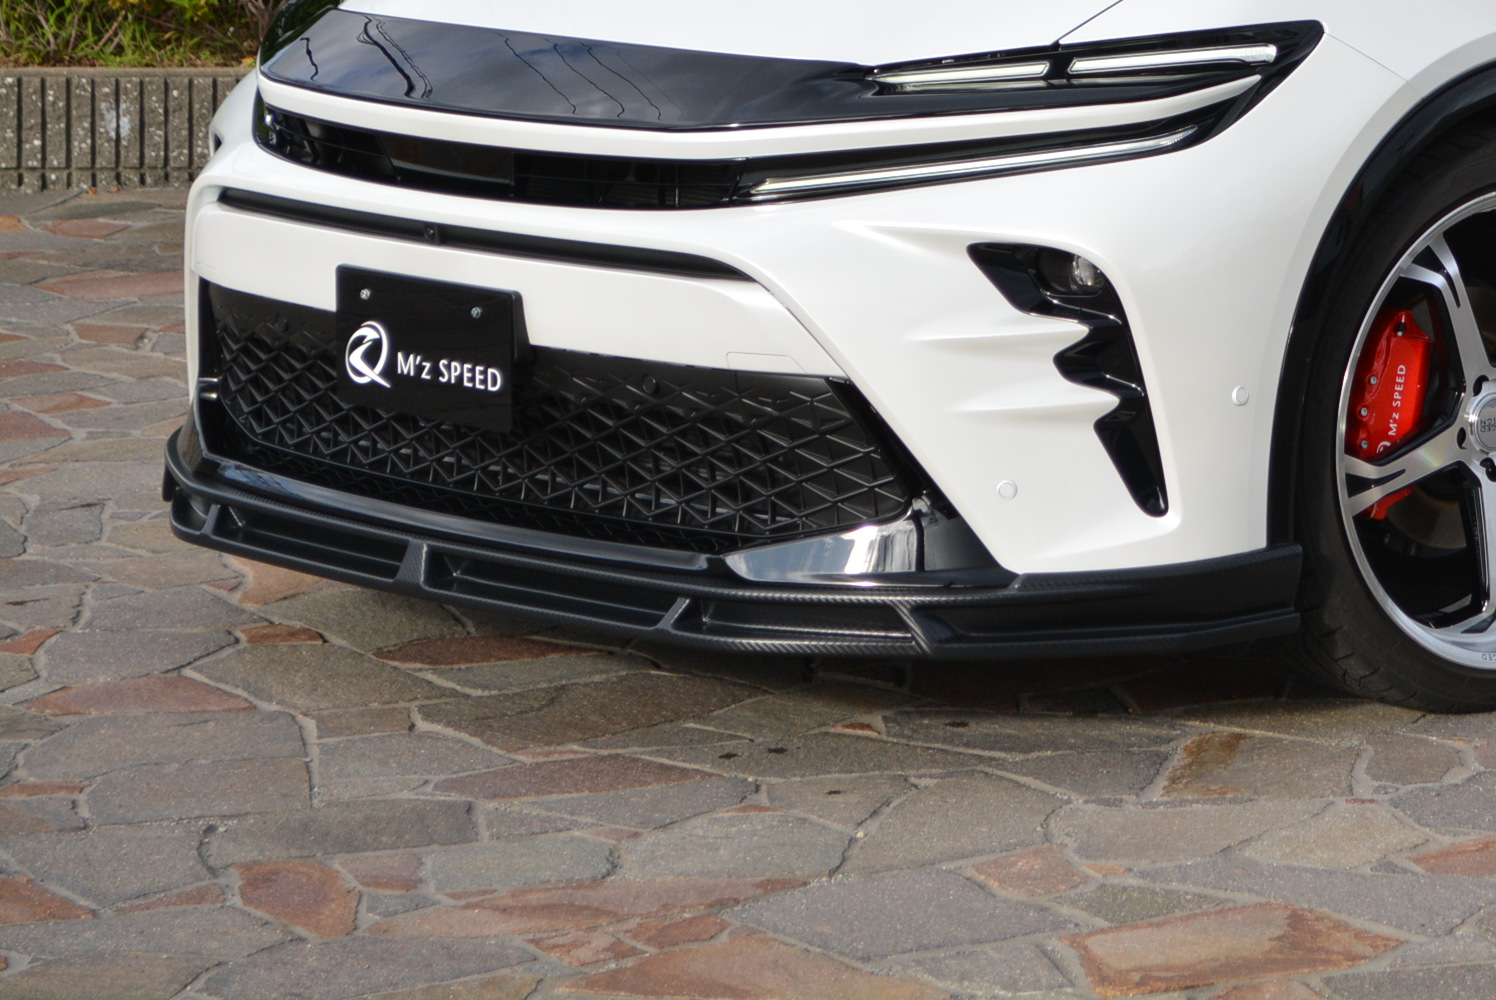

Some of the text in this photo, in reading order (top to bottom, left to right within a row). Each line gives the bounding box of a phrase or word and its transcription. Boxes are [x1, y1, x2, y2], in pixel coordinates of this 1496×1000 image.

[397, 352, 502, 392] M'z SPEED
[1387, 364, 1406, 436] M'z SPEED
